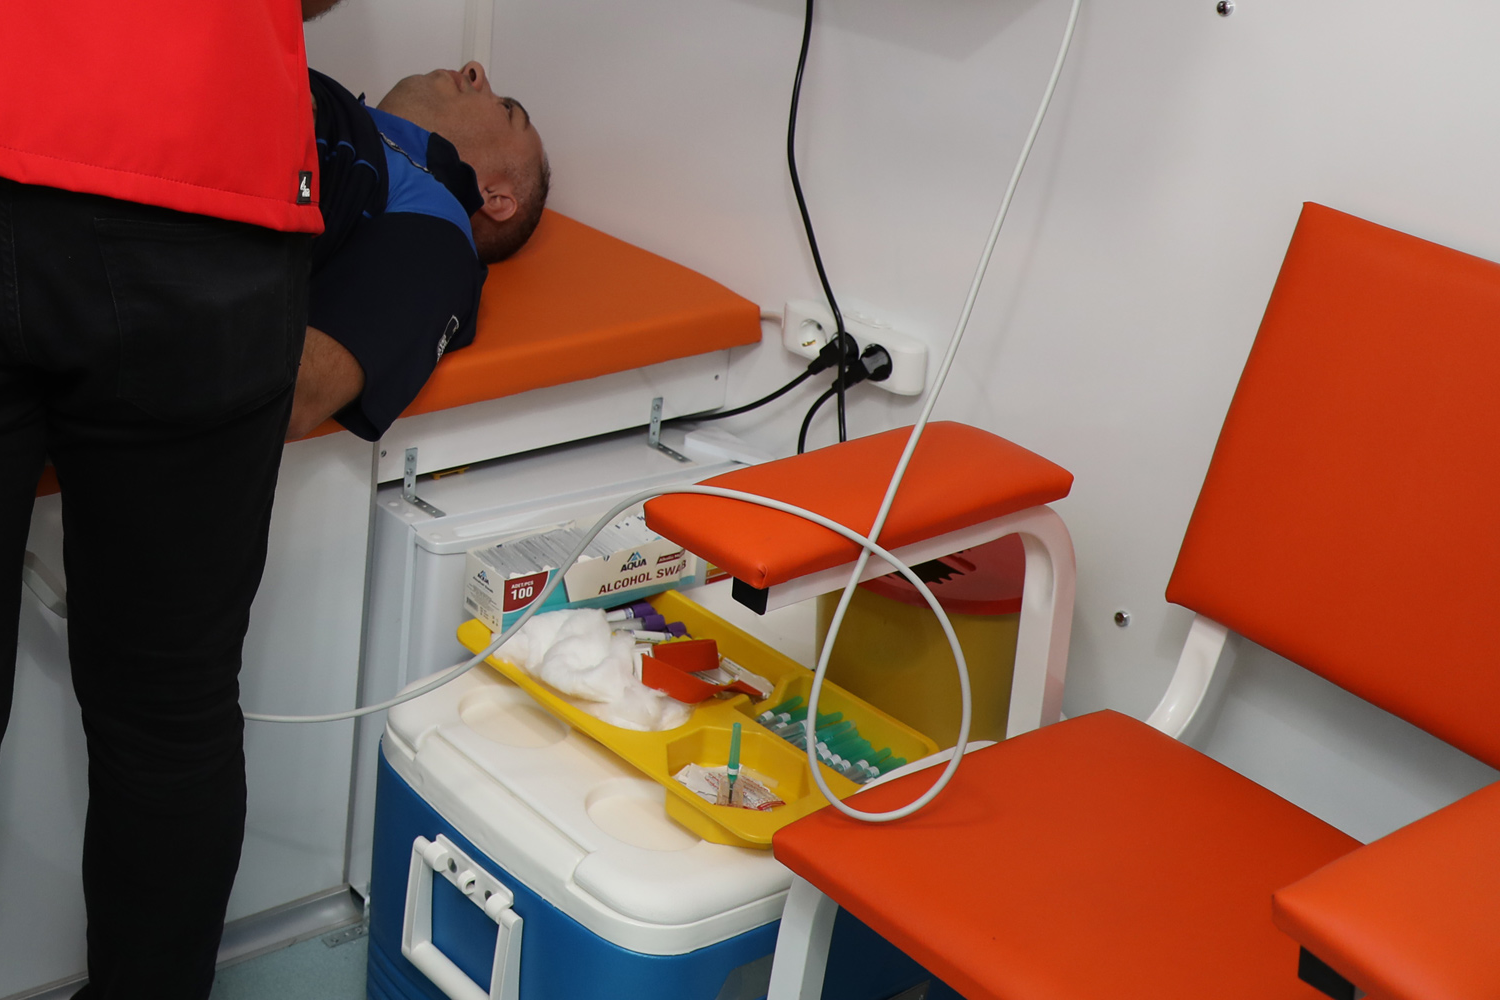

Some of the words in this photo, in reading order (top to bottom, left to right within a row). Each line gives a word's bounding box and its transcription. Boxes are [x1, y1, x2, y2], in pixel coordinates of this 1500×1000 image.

[620, 558, 647, 573] AQUA
[598, 572, 652, 595] ALCOHOL
[656, 559, 687, 579] SWAB
[511, 586, 533, 601] 100
